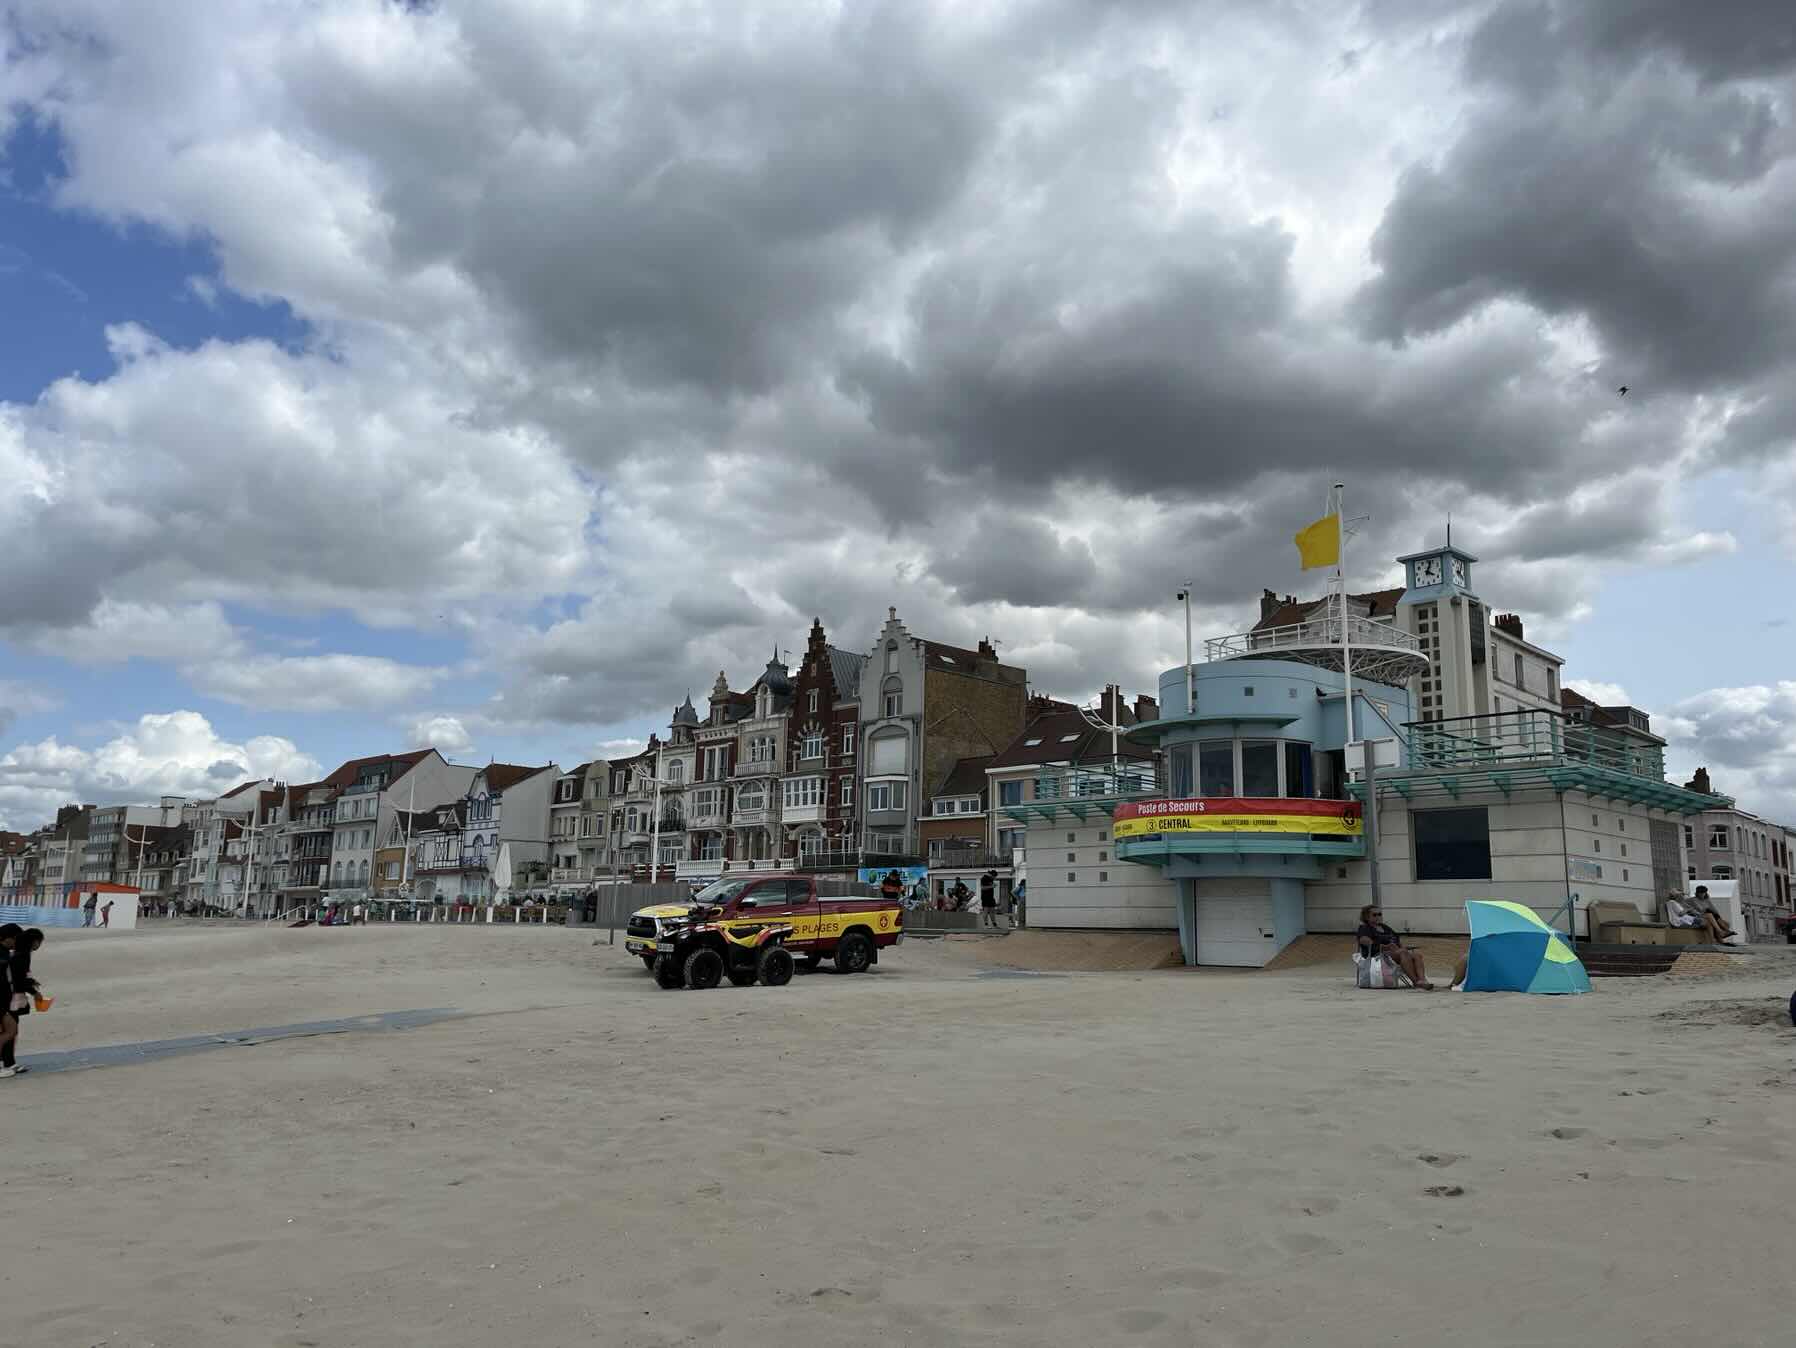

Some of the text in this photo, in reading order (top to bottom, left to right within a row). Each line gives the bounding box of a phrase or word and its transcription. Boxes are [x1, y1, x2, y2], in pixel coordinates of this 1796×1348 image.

[1138, 801, 1205, 815] Poste de Secours
[1159, 818, 1192, 829] CENTRAL
[802, 923, 839, 934] PLAGES
